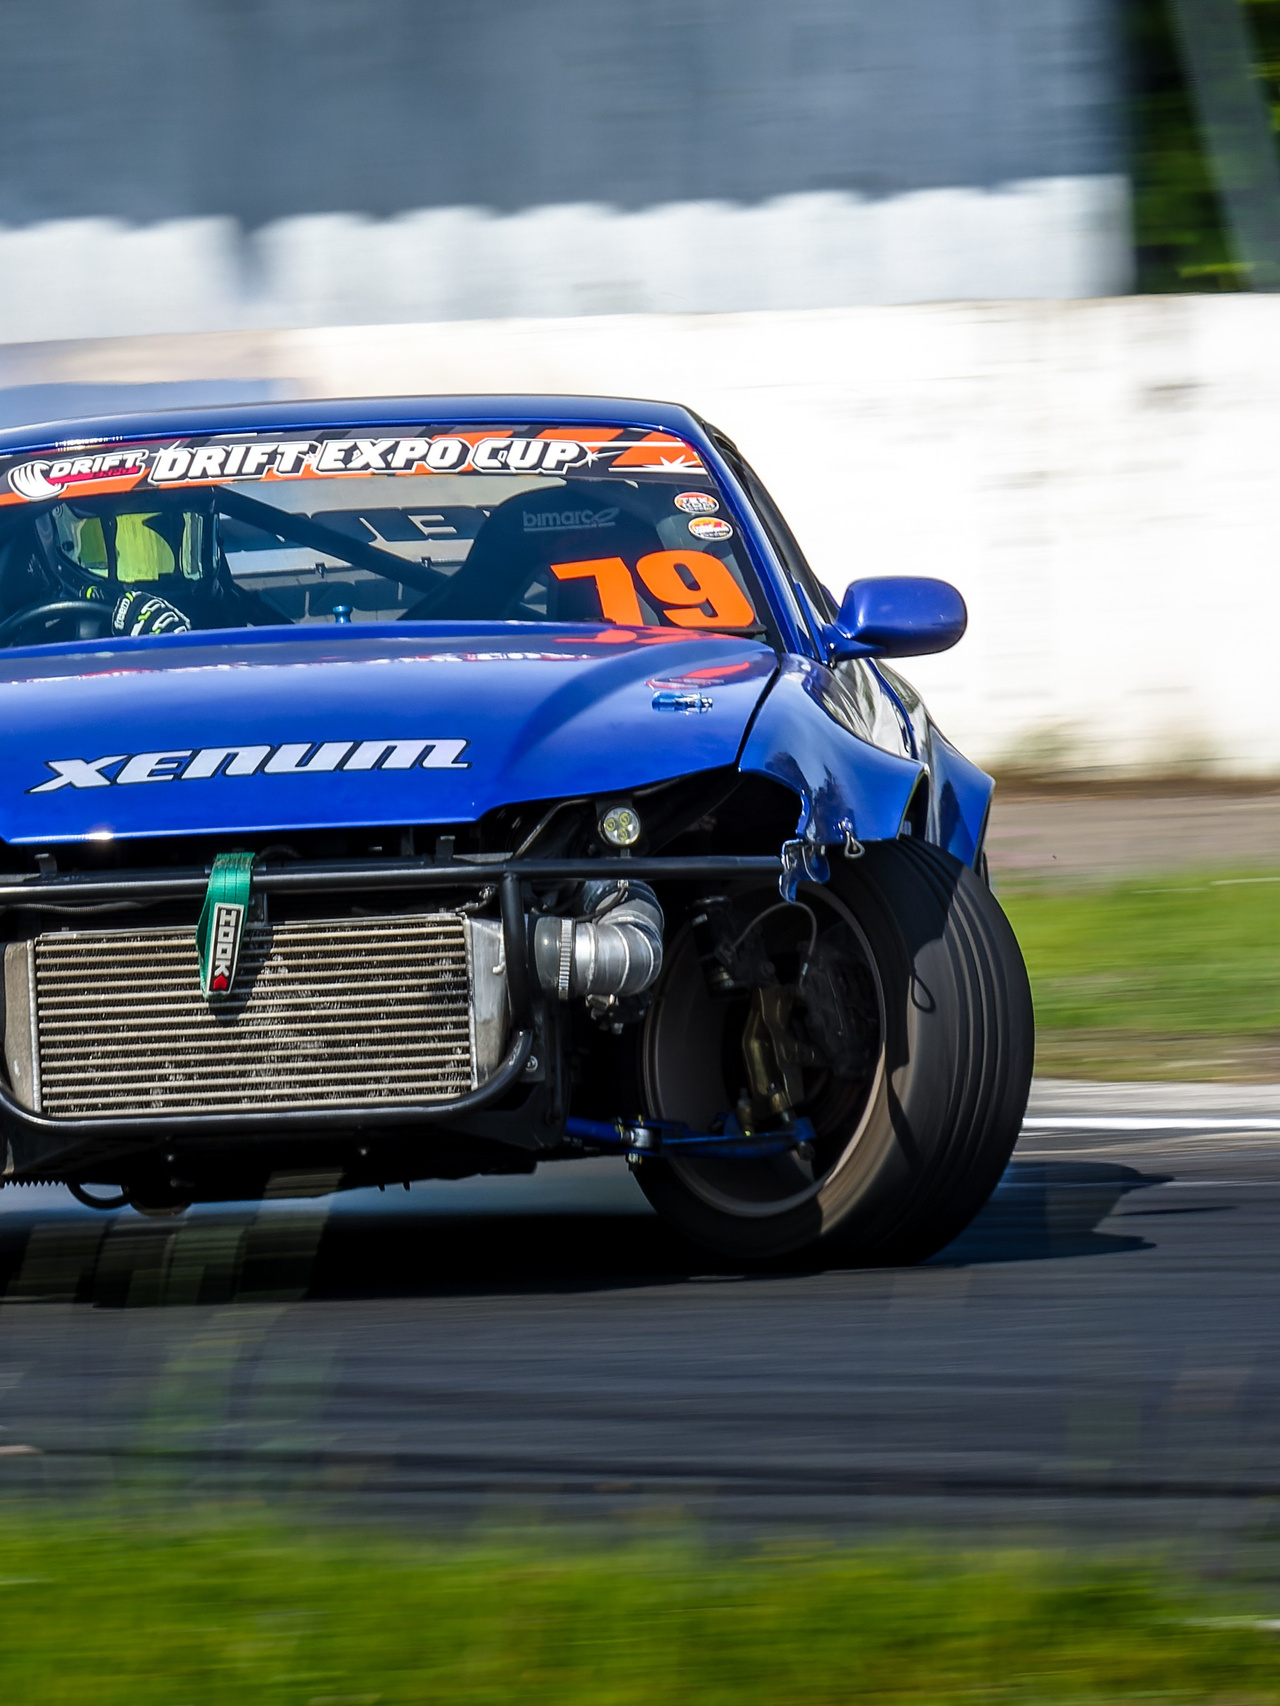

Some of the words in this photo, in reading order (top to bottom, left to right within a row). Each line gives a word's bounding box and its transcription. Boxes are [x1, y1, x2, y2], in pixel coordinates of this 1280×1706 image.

[49, 453, 140, 479] DRIFT
[153, 443, 310, 481] DRIFT
[322, 439, 463, 471] EXPO
[473, 440, 579, 470] CUP
[550, 549, 755, 627] 79
[214, 909, 238, 977] HOOK
